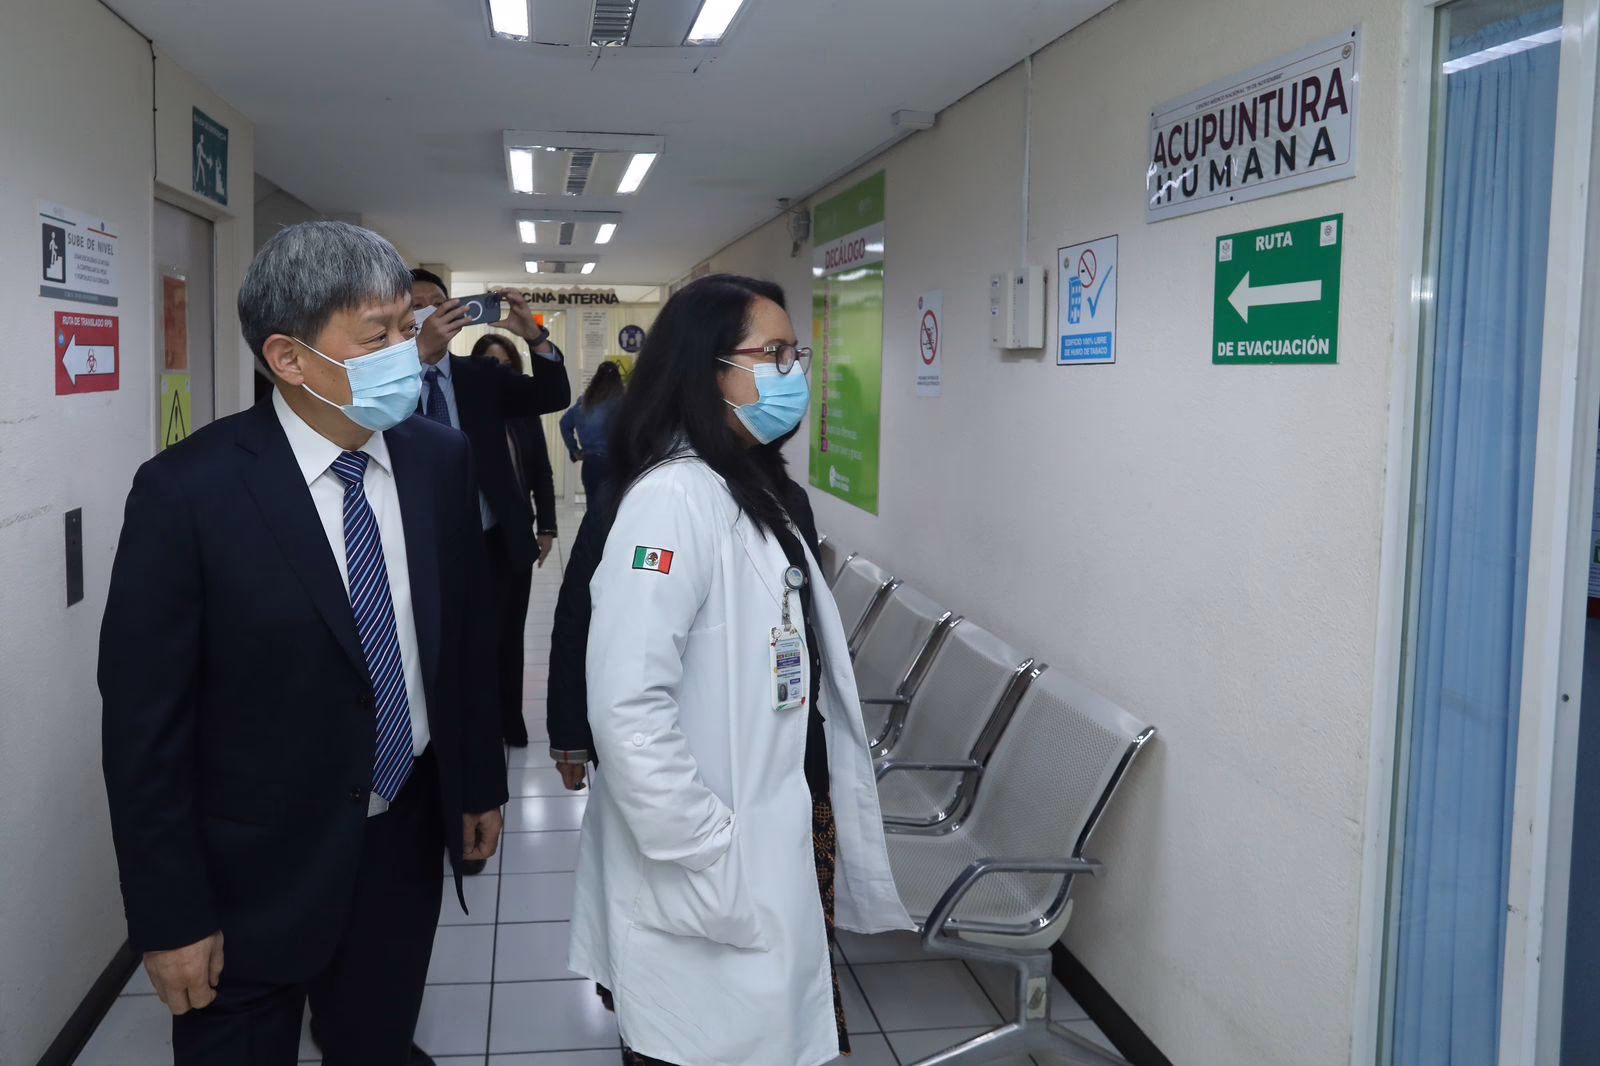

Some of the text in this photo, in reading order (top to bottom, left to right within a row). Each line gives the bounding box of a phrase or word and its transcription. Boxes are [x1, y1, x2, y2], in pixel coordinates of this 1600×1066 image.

[1154, 67, 1349, 169] ACUPUNTURA
[1157, 126, 1336, 205] HUMANA
[67, 232, 114, 256] SUBE DE NIVEL
[1256, 230, 1294, 251] RUTA
[825, 237, 866, 269] DECÁLOGO
[519, 292, 620, 304] CINA INTERNA
[74, 316, 81, 326] DE
[1217, 335, 1330, 357] DE EVACUACIÓN
